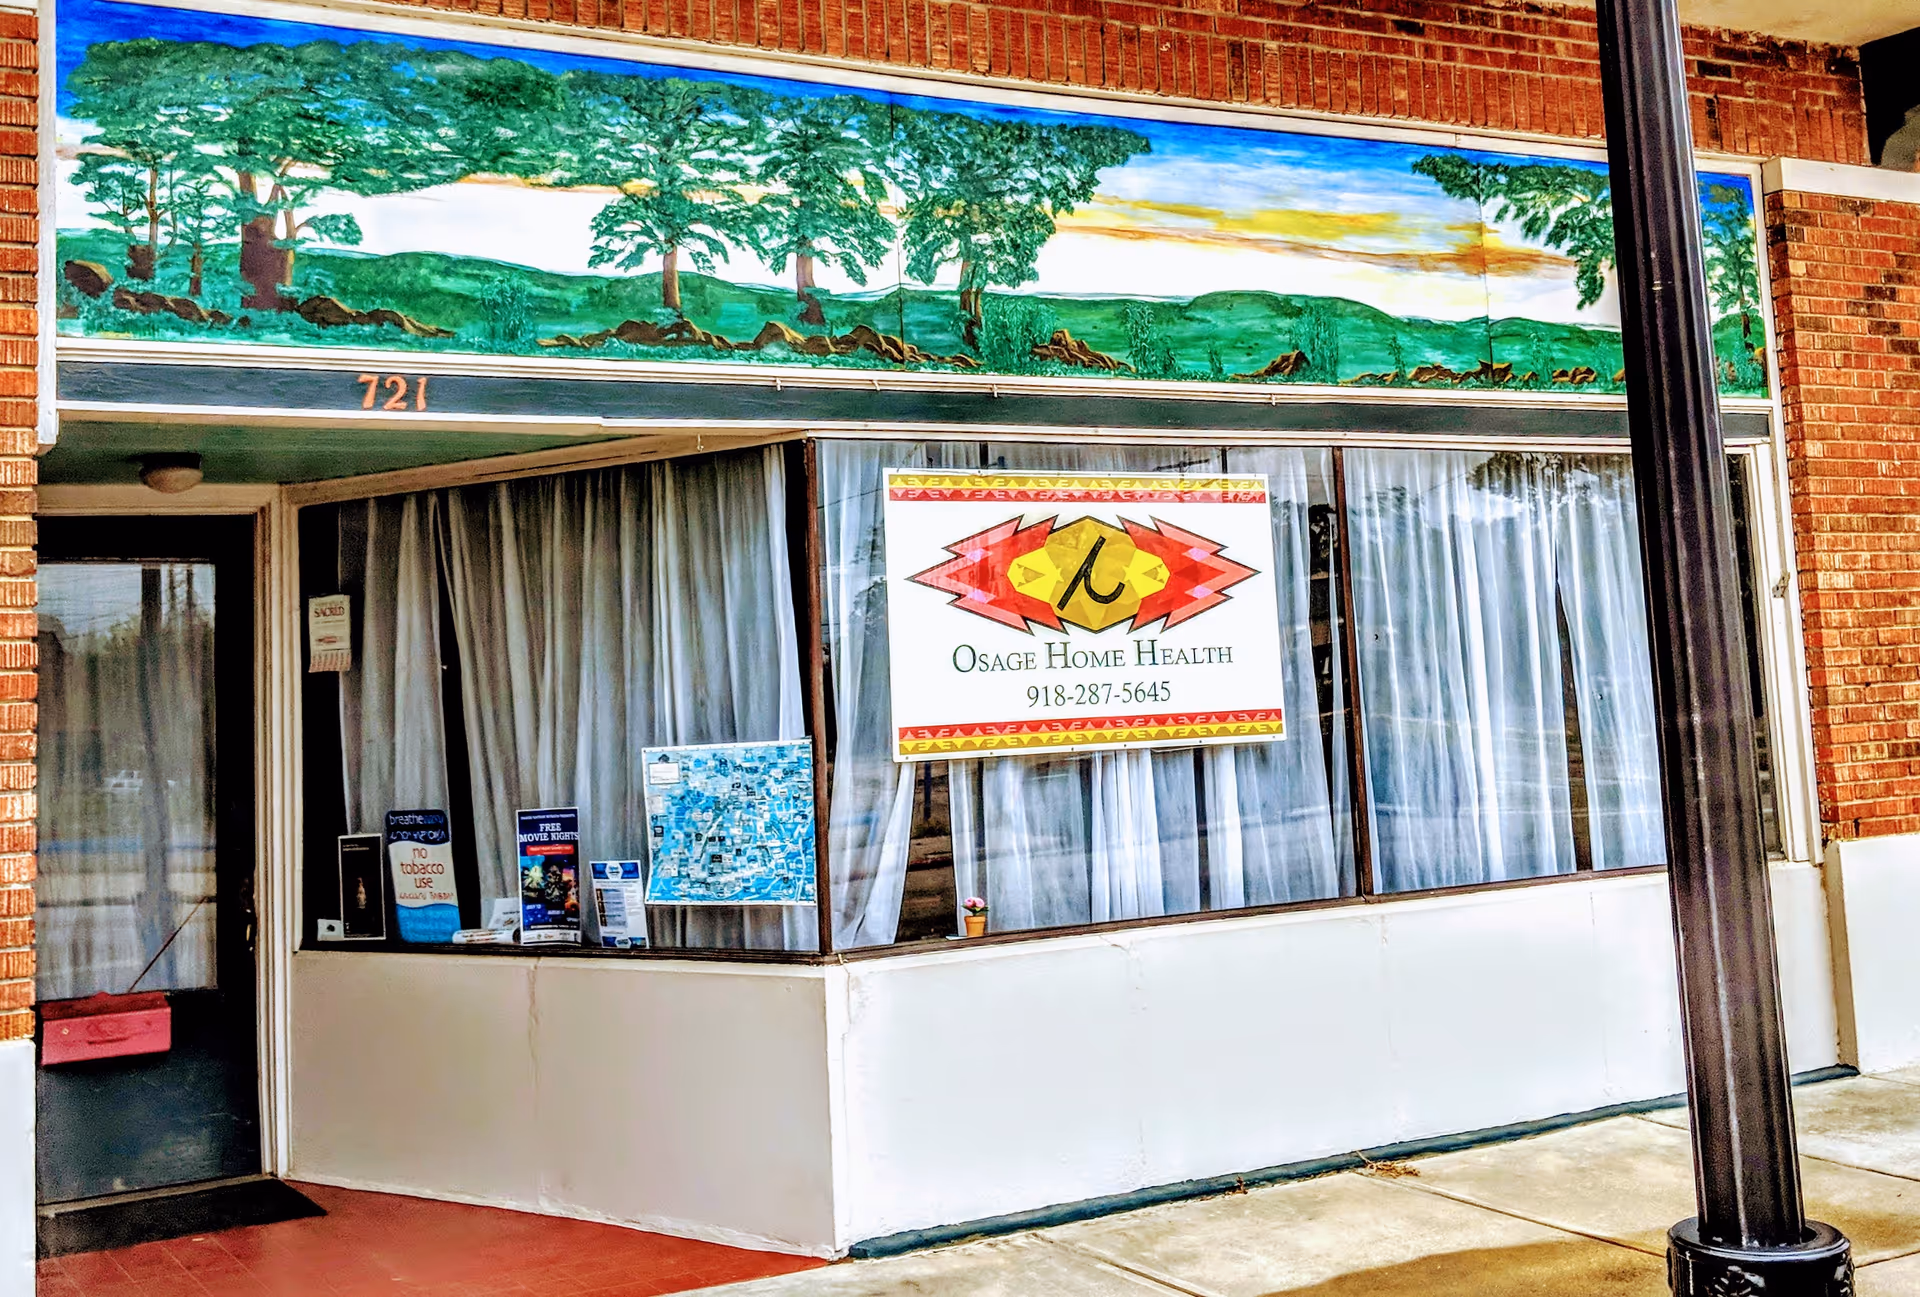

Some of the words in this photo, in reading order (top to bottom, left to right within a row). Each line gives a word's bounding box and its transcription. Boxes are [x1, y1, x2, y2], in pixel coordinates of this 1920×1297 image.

[357, 374, 427, 411] 721
[952, 644, 1037, 673] OSAGE
[1044, 641, 1126, 670] HOME
[1133, 639, 1234, 667] HEALTH
[1026, 681, 1172, 708] 918-287-5645
[539, 822, 562, 832] FREE
[519, 833, 549, 843] MOVIE
[550, 831, 579, 841] NIGHTS
[412, 848, 428, 859] no
[400, 860, 445, 875] tobacco
[414, 877, 433, 889] use
